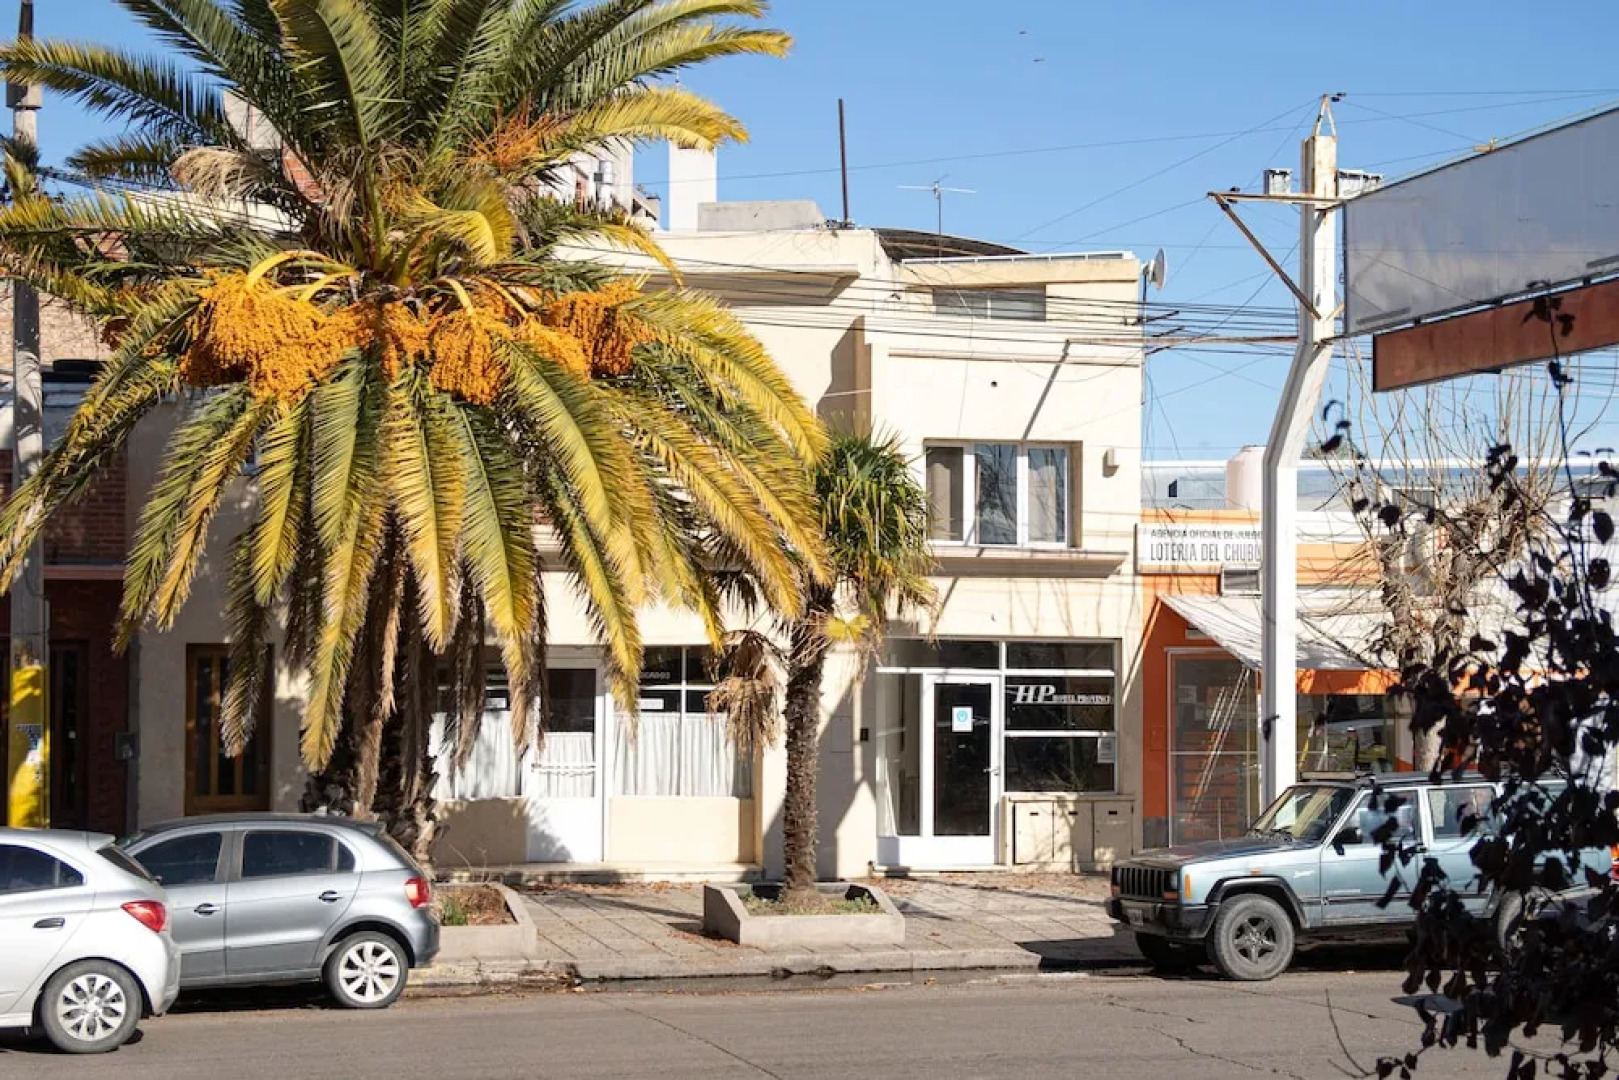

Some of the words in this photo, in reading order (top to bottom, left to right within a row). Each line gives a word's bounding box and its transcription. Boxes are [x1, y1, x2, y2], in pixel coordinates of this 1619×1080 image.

[1150, 543, 1198, 562] LOTERIA
[1201, 543, 1219, 562] DEL
[1224, 543, 1262, 562] CHUBU
[1010, 685, 1056, 704] HP
